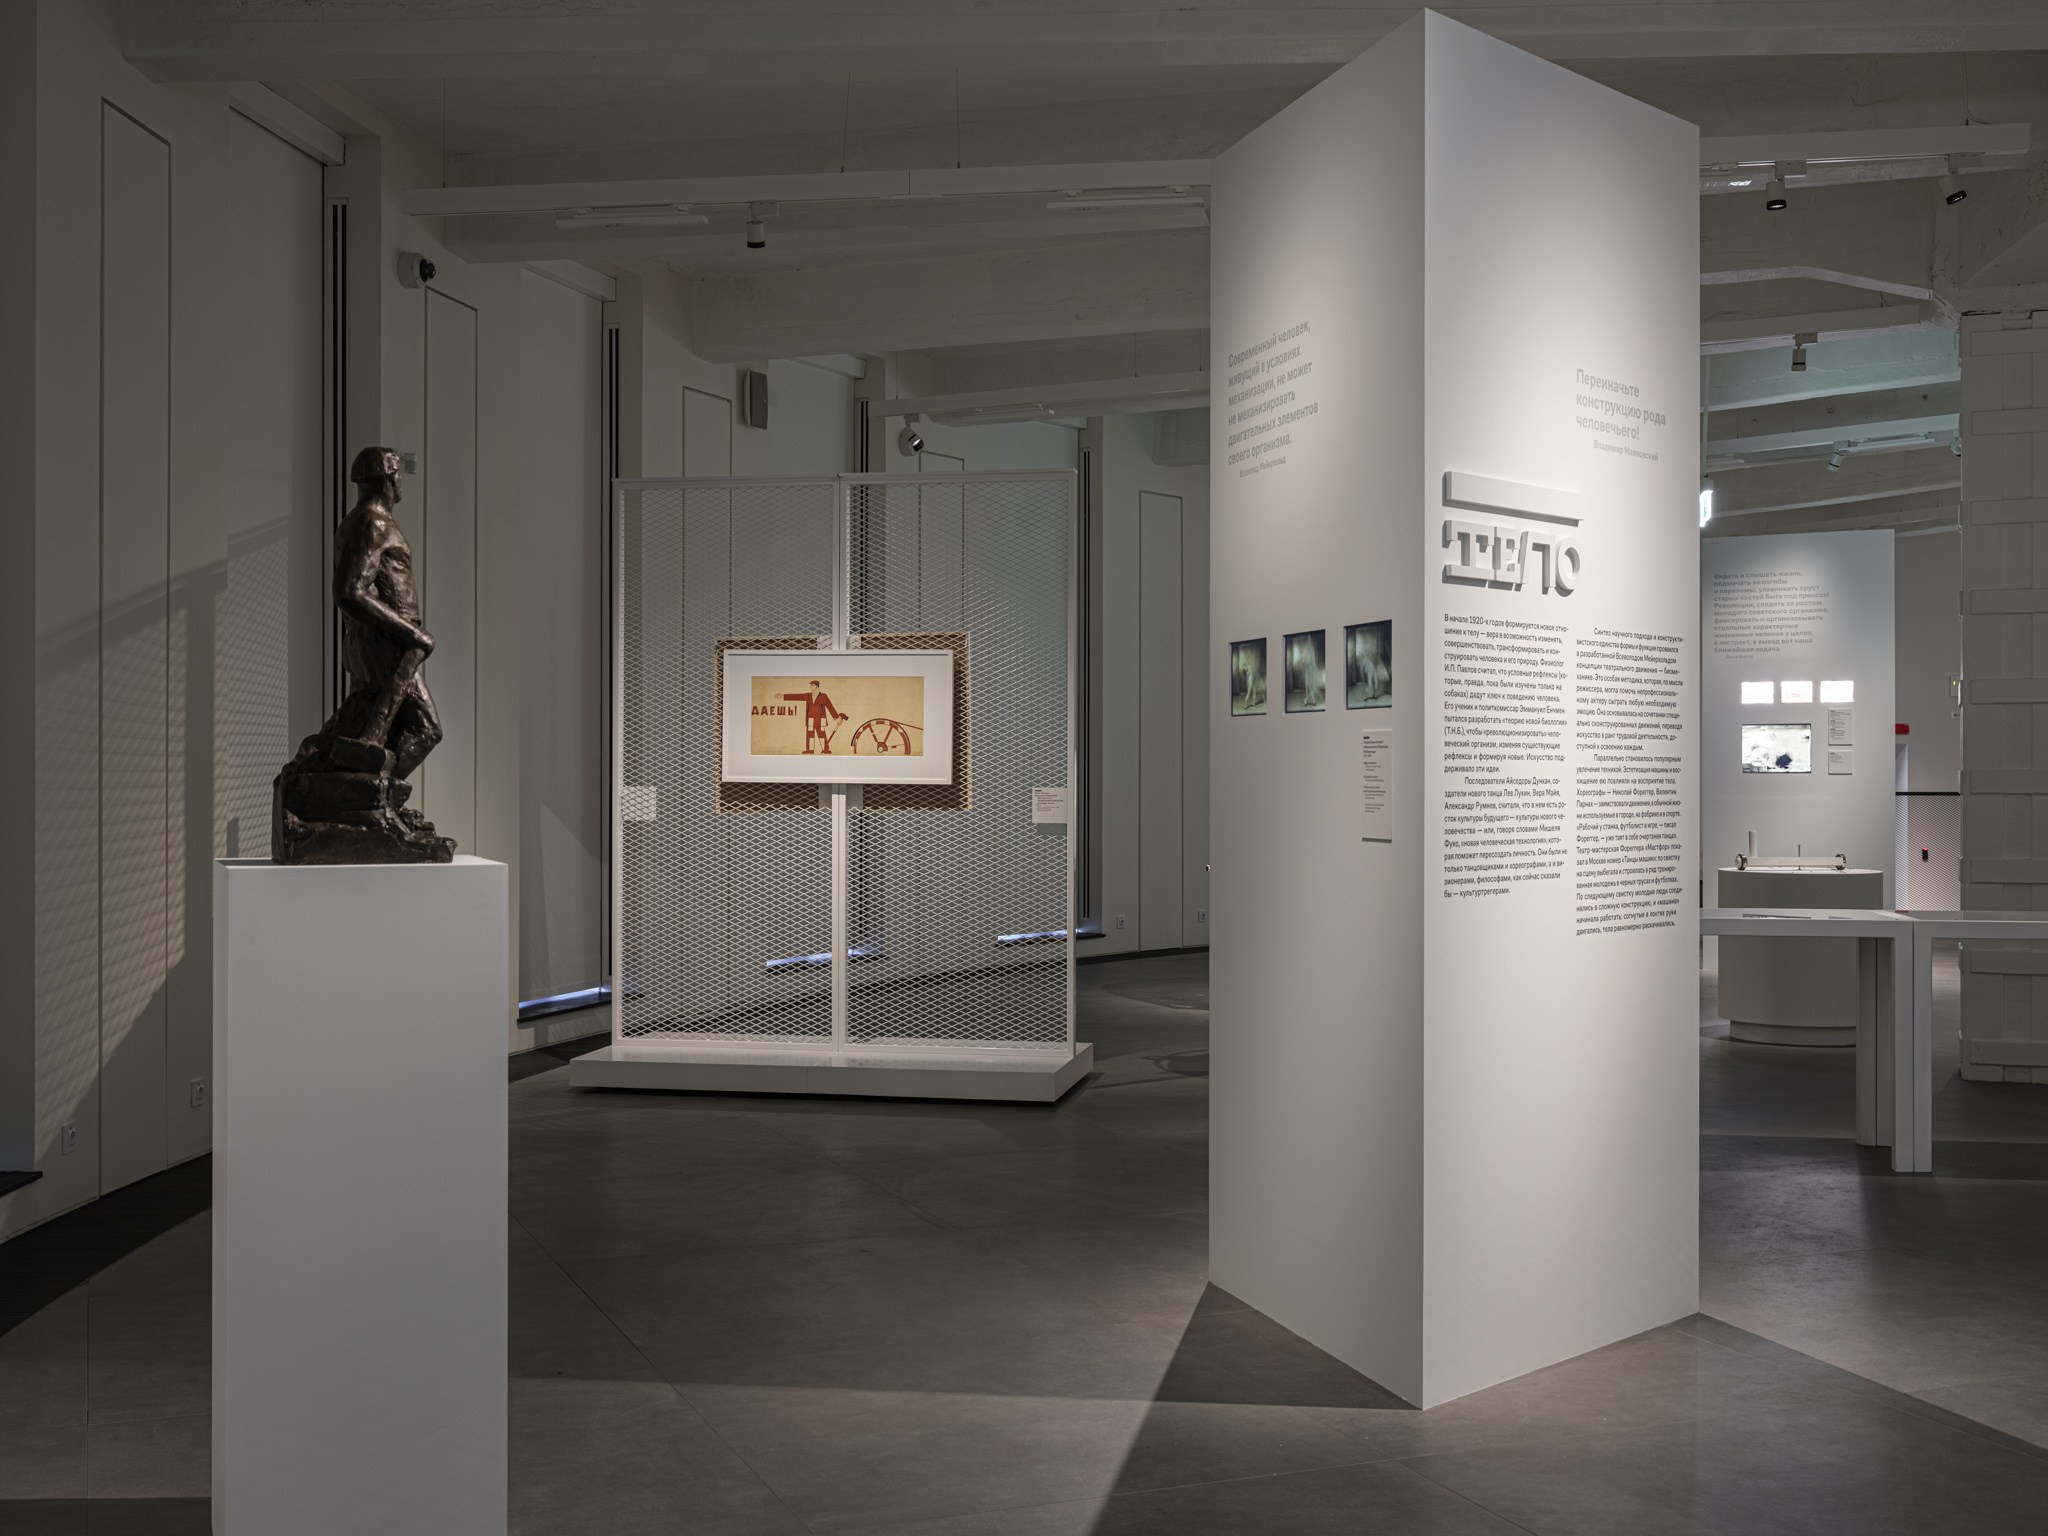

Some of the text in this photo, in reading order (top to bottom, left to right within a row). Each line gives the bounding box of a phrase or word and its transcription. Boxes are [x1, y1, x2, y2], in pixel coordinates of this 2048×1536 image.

[1229, 321, 1310, 367] Современный человек,
[1228, 346, 1300, 387] живущий в условиях
[1577, 368, 1639, 397] Переиначьте
[1229, 362, 1312, 406] механизации, не может
[1228, 403, 1318, 448] двигательных элементов
[1229, 391, 1295, 426] не механизировать
[1577, 394, 1666, 427] конструкцию рода
[1577, 416, 1639, 440] человечьего!
[1229, 434, 1291, 465] своего организма.
[1594, 440, 1658, 460] Владимир Маяковский
[1442, 519, 1581, 595] ТЕЛО
[752, 706, 797, 716] ДАЕШЬ!
